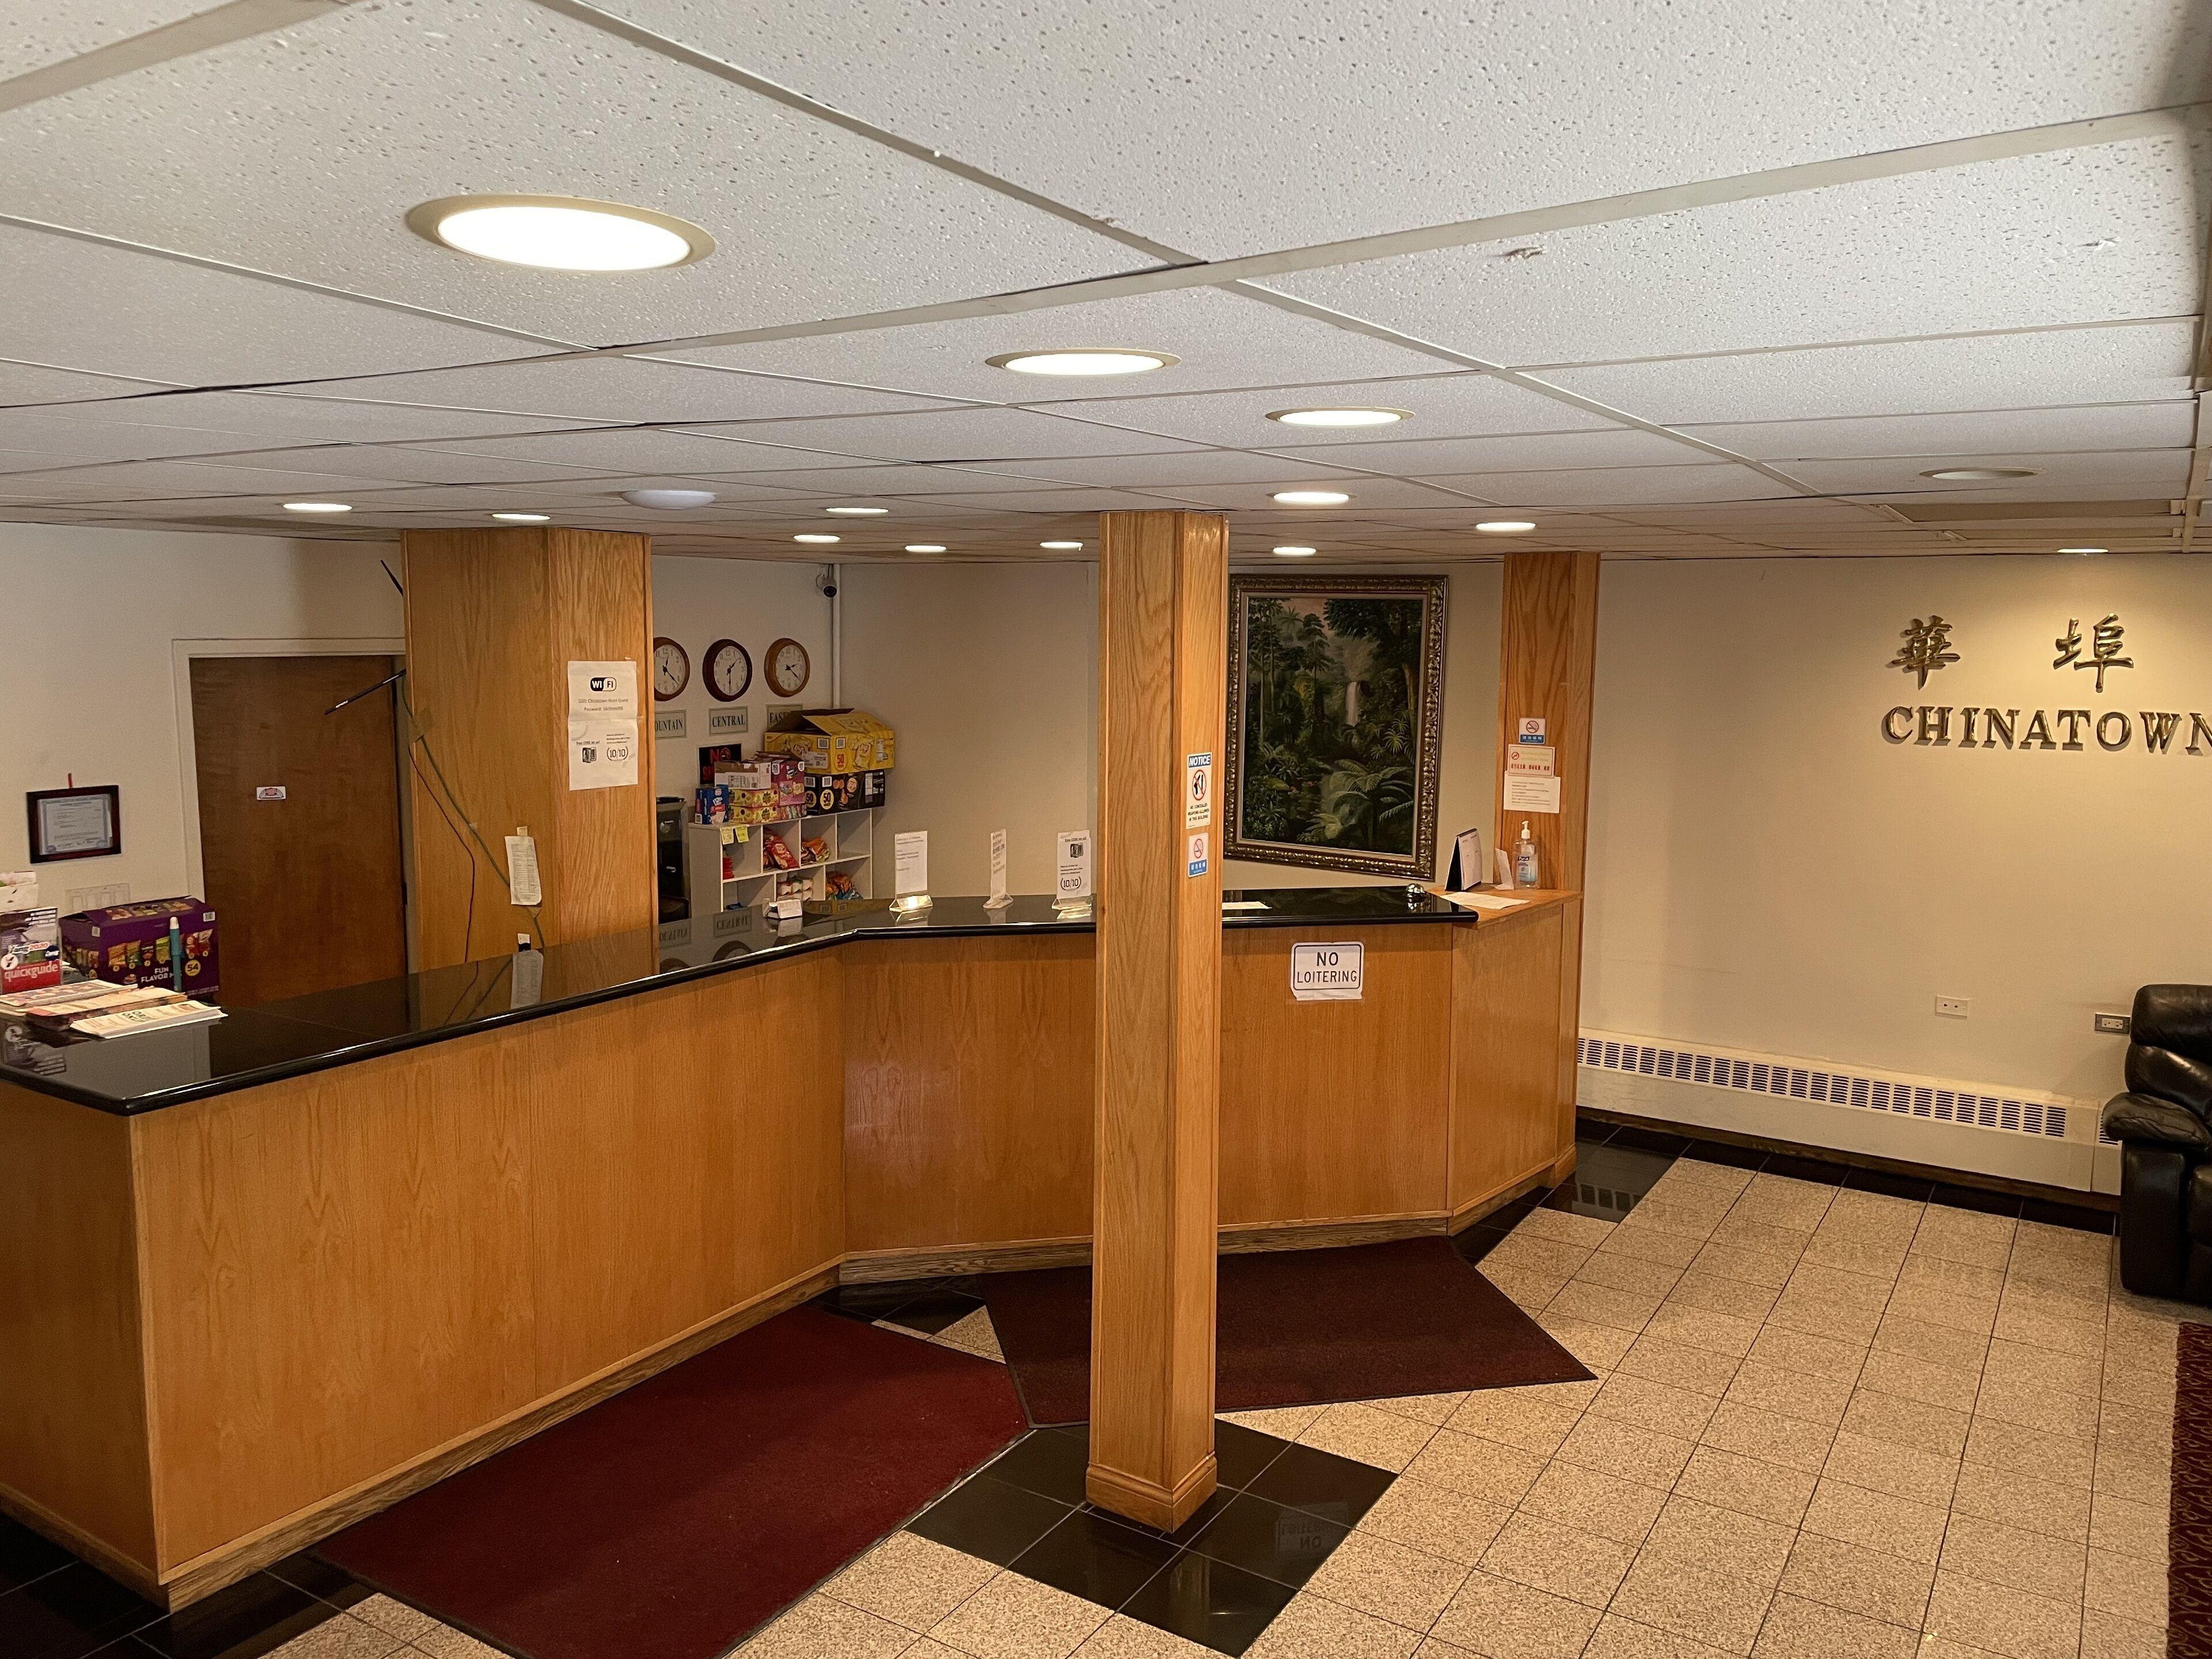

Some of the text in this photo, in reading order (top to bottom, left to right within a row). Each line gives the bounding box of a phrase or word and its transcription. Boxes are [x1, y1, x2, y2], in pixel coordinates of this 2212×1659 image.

[655, 719, 683, 732] OUNTAIN
[712, 714, 745, 728] CENTRAL
[1881, 705, 2212, 755] CHINATOWN
[837, 753, 844, 764] 50
[1189, 755, 1211, 766] NOTICE
[823, 791, 831, 803] 50
[1063, 878, 1079, 888] 10/10
[1316, 952, 1339, 967] NO
[5, 961, 59, 982] quickguide
[141, 973, 169, 983] FLAVOR
[1297, 970, 1357, 983] LOITERING
